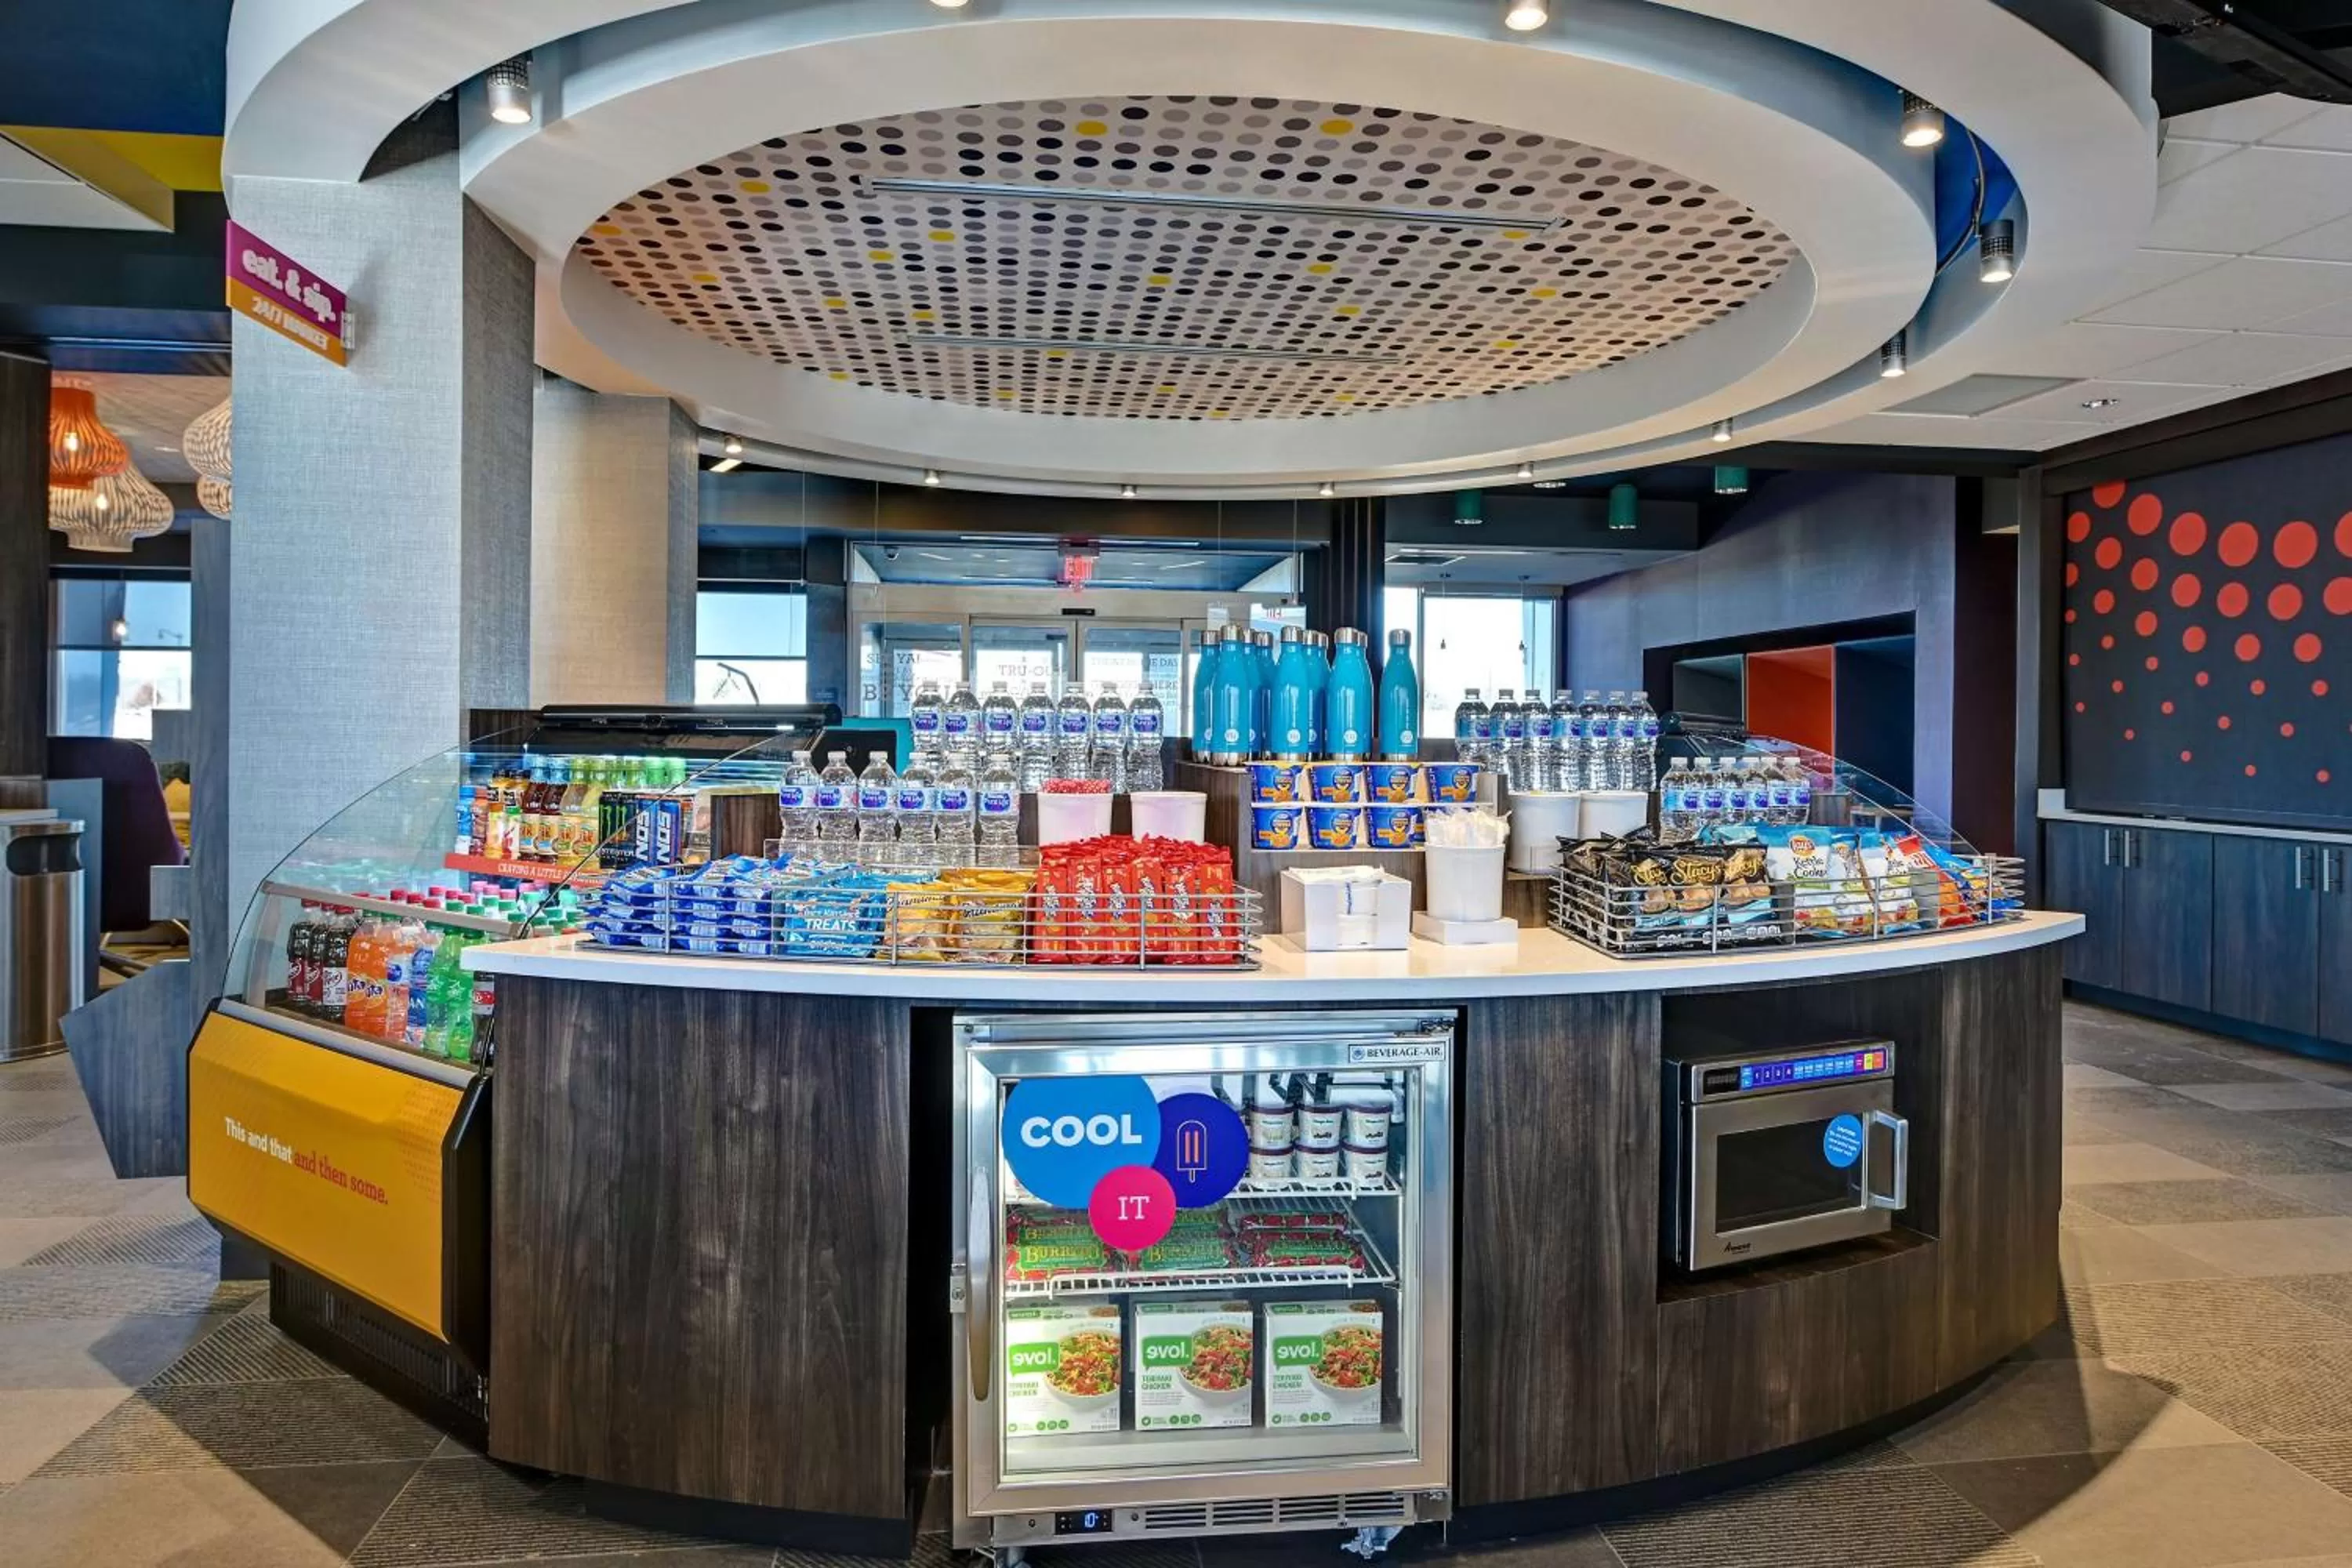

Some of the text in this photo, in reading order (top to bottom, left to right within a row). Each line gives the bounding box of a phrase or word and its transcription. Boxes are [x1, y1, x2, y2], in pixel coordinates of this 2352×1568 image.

[285, 269, 302, 302] &
[804, 918, 857, 931] TREATS
[1021, 1113, 1142, 1148] COOL
[225, 1116, 388, 1204] This and that and then some.
[1118, 1196, 1149, 1220] IT
